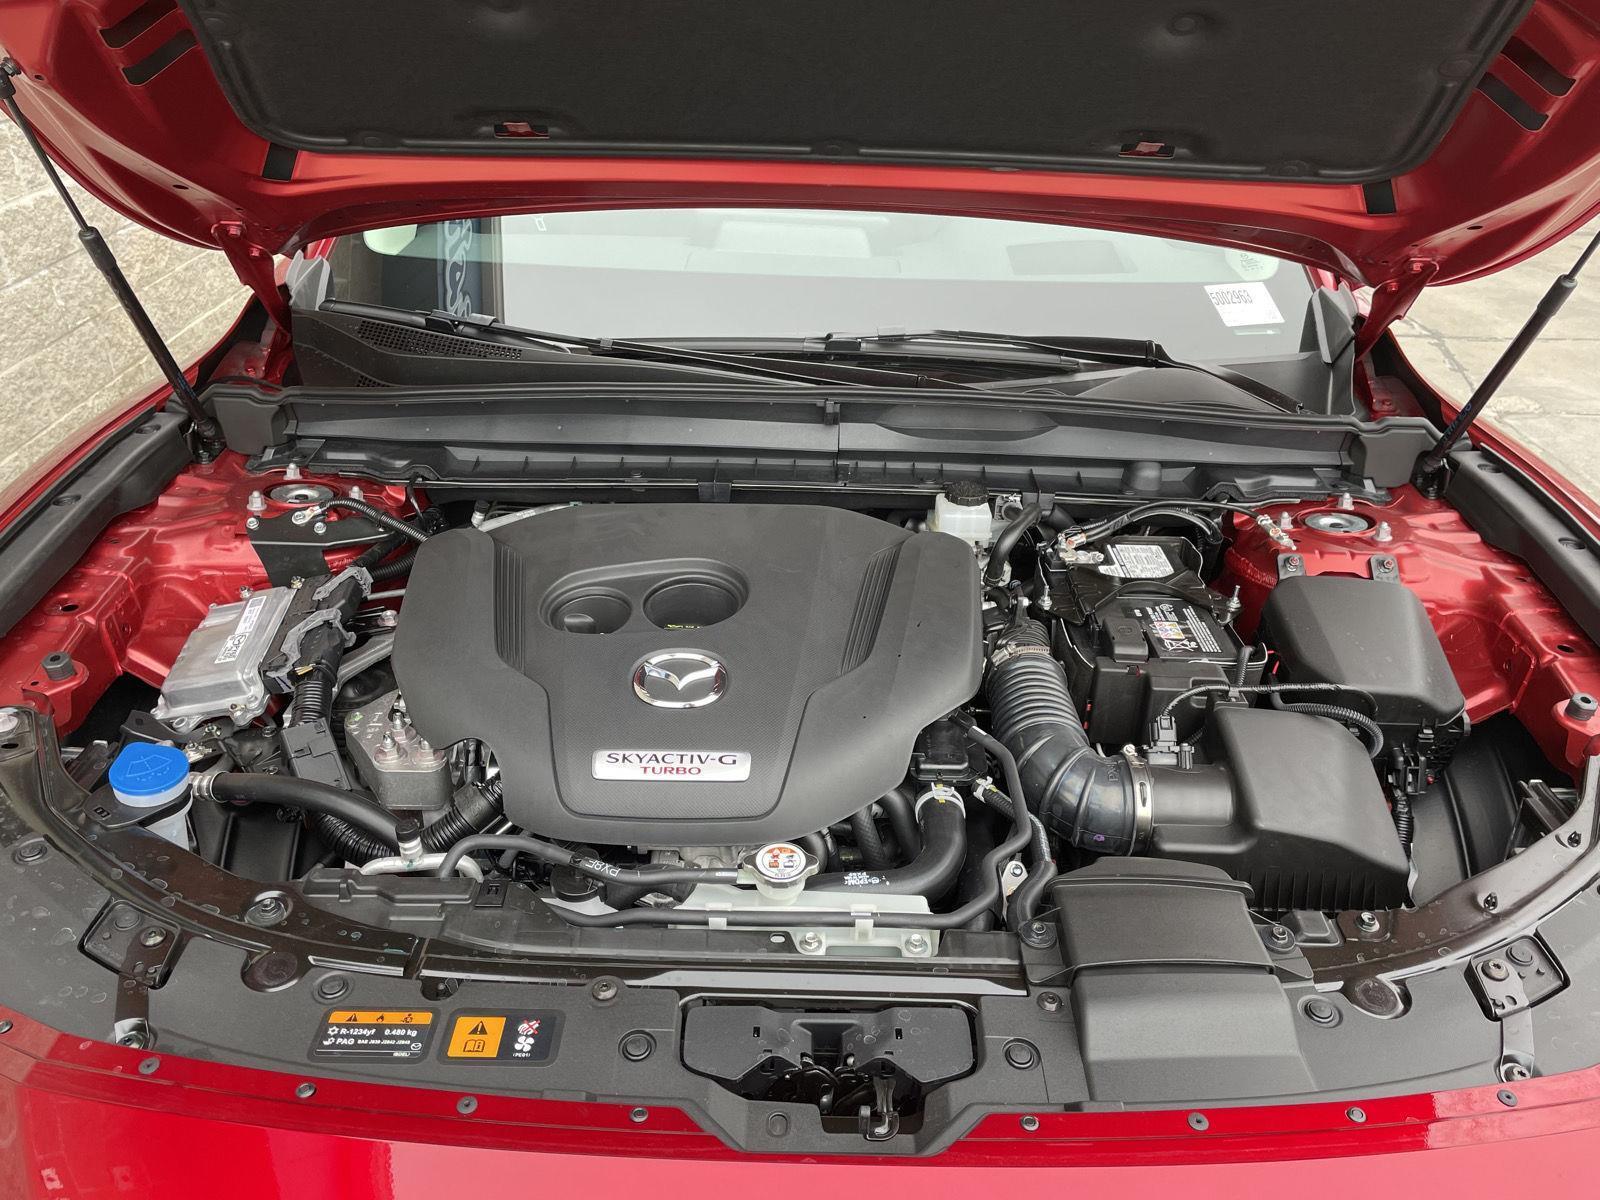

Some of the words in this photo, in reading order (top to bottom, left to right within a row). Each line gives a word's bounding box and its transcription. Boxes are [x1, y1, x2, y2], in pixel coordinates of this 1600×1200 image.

[1209, 289, 1253, 306] 5002963
[606, 752, 738, 765] SKYACTIV-G
[640, 766, 702, 775] TURBO
[339, 1028, 376, 1036] R-1234yf
[384, 1028, 406, 1036] 0.480
[406, 1028, 418, 1037] kg
